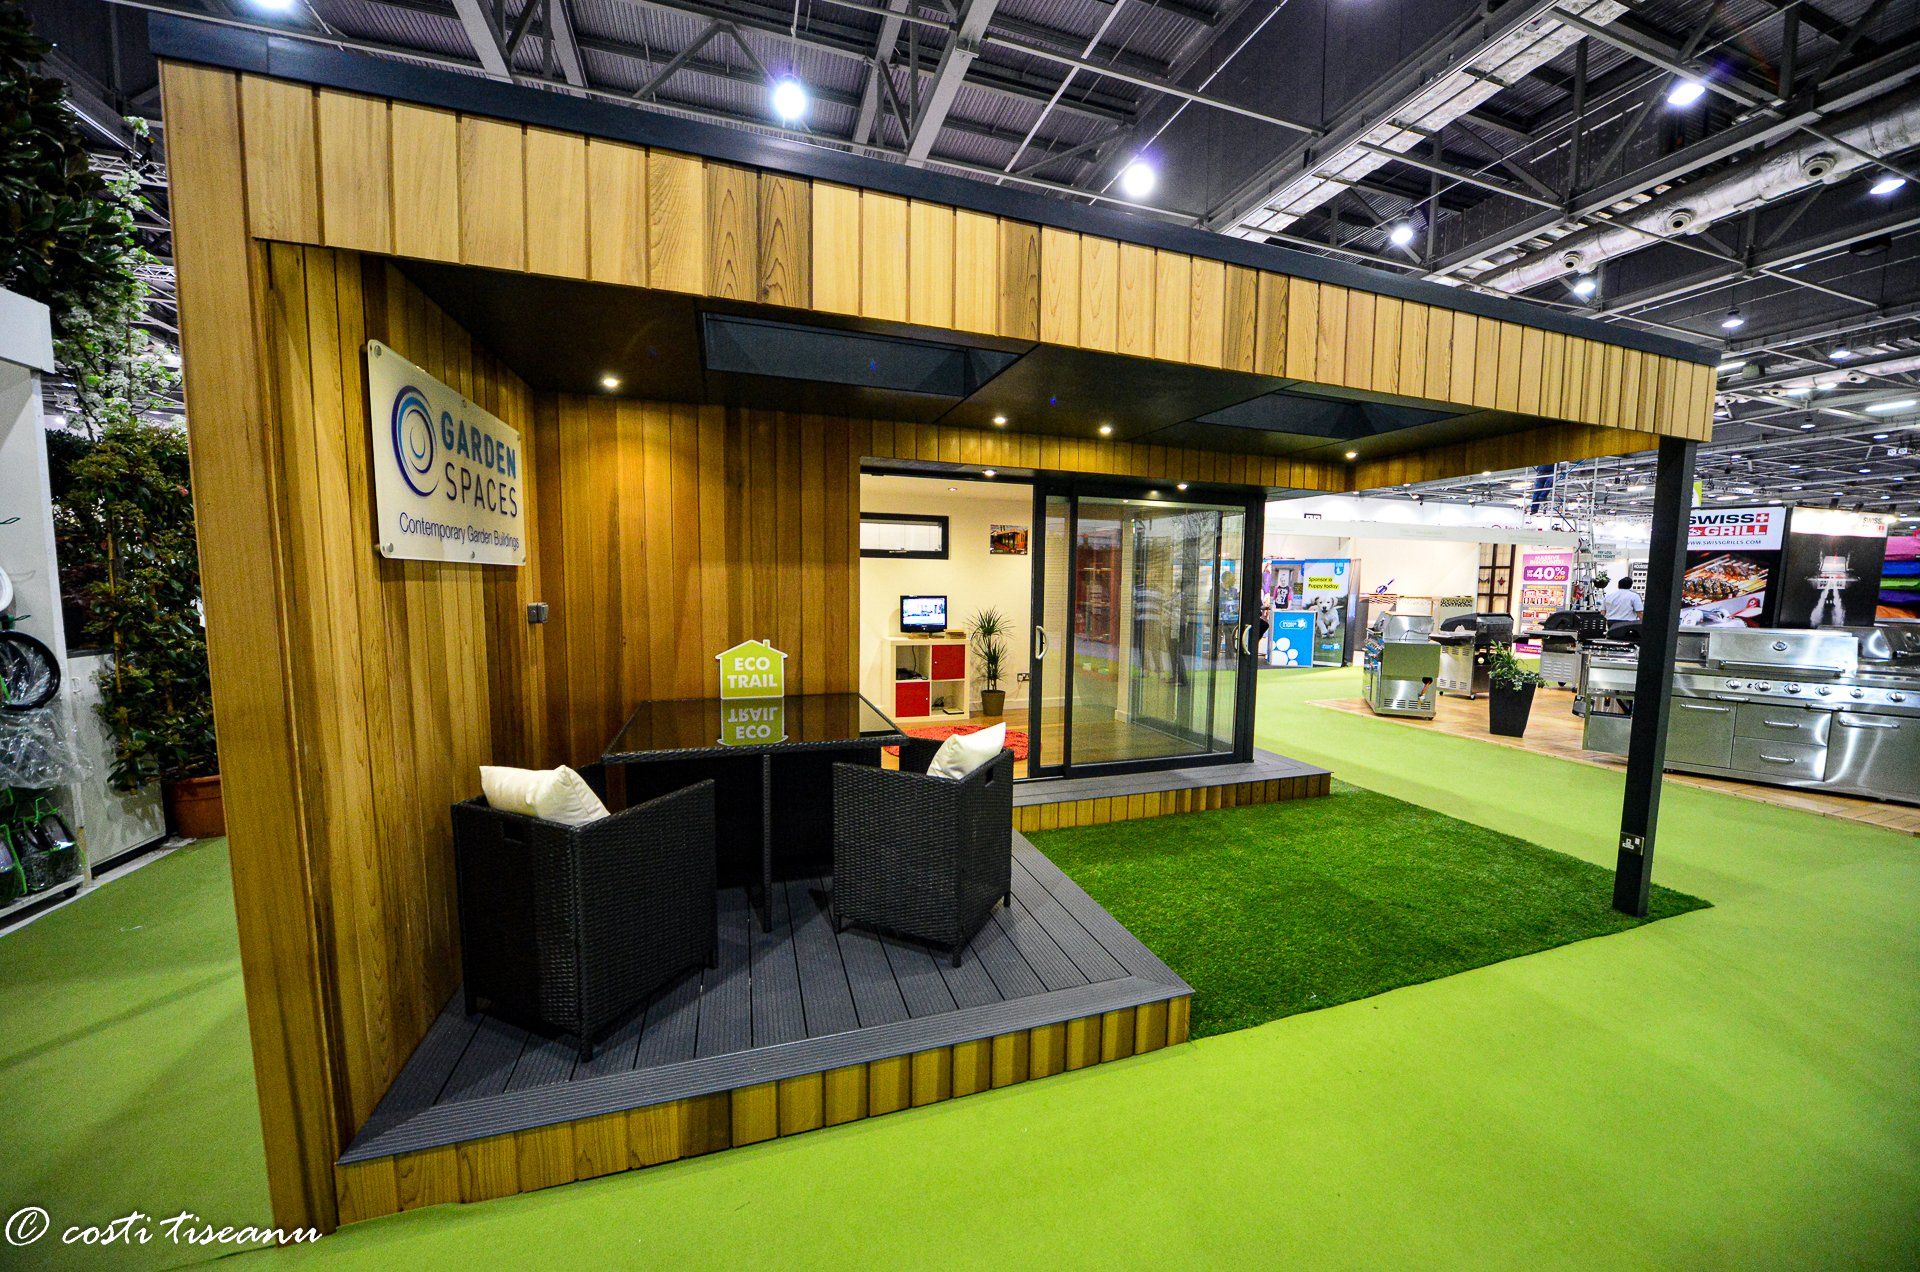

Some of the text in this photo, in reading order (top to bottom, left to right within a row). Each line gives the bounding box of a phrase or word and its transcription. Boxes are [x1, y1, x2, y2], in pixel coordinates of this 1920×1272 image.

[441, 411, 517, 479] GARDEN
[445, 462, 517, 517] SPACES
[400, 512, 520, 552] Contemporary Garden Buildings
[1704, 525, 1767, 536] GRILL
[1533, 567, 1566, 580] 40%
[734, 656, 771, 672] ECO
[727, 674, 778, 689] TRAIL
